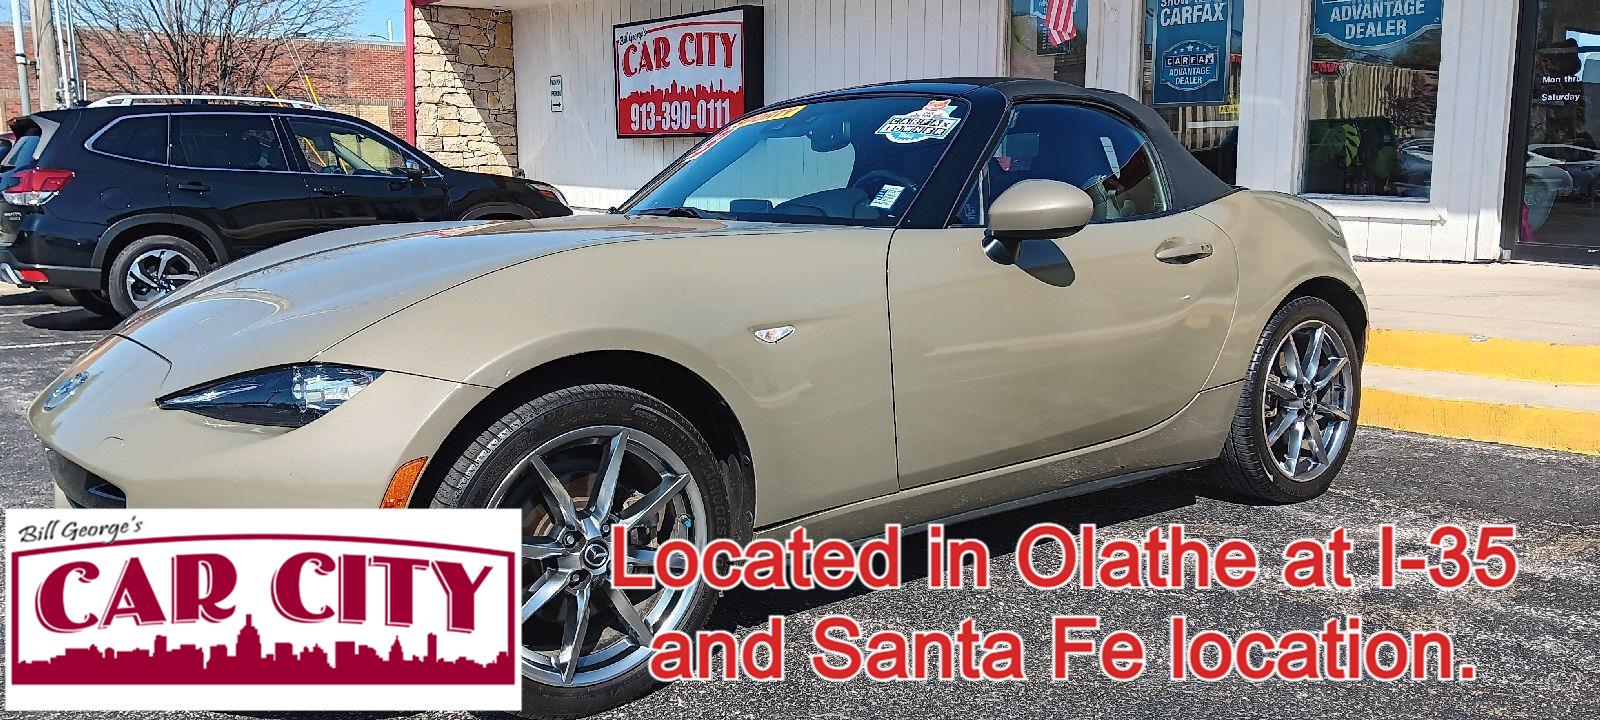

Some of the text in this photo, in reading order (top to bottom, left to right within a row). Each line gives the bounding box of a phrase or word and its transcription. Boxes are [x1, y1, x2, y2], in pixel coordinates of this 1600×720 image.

[1160, 3, 1225, 27] CARFAX
[1330, 0, 1426, 22] ADVANTAGE
[1344, 19, 1407, 39] DEALER
[622, 32, 738, 77] CAR CITY
[1166, 53, 1215, 66] CARFAX
[1168, 67, 1211, 77] ADVANTAGE
[1175, 77, 1203, 85] DEALER
[1541, 93, 1580, 102] Saturday
[630, 98, 730, 131] 913-390-0111
[889, 117, 951, 128] CARFAX
